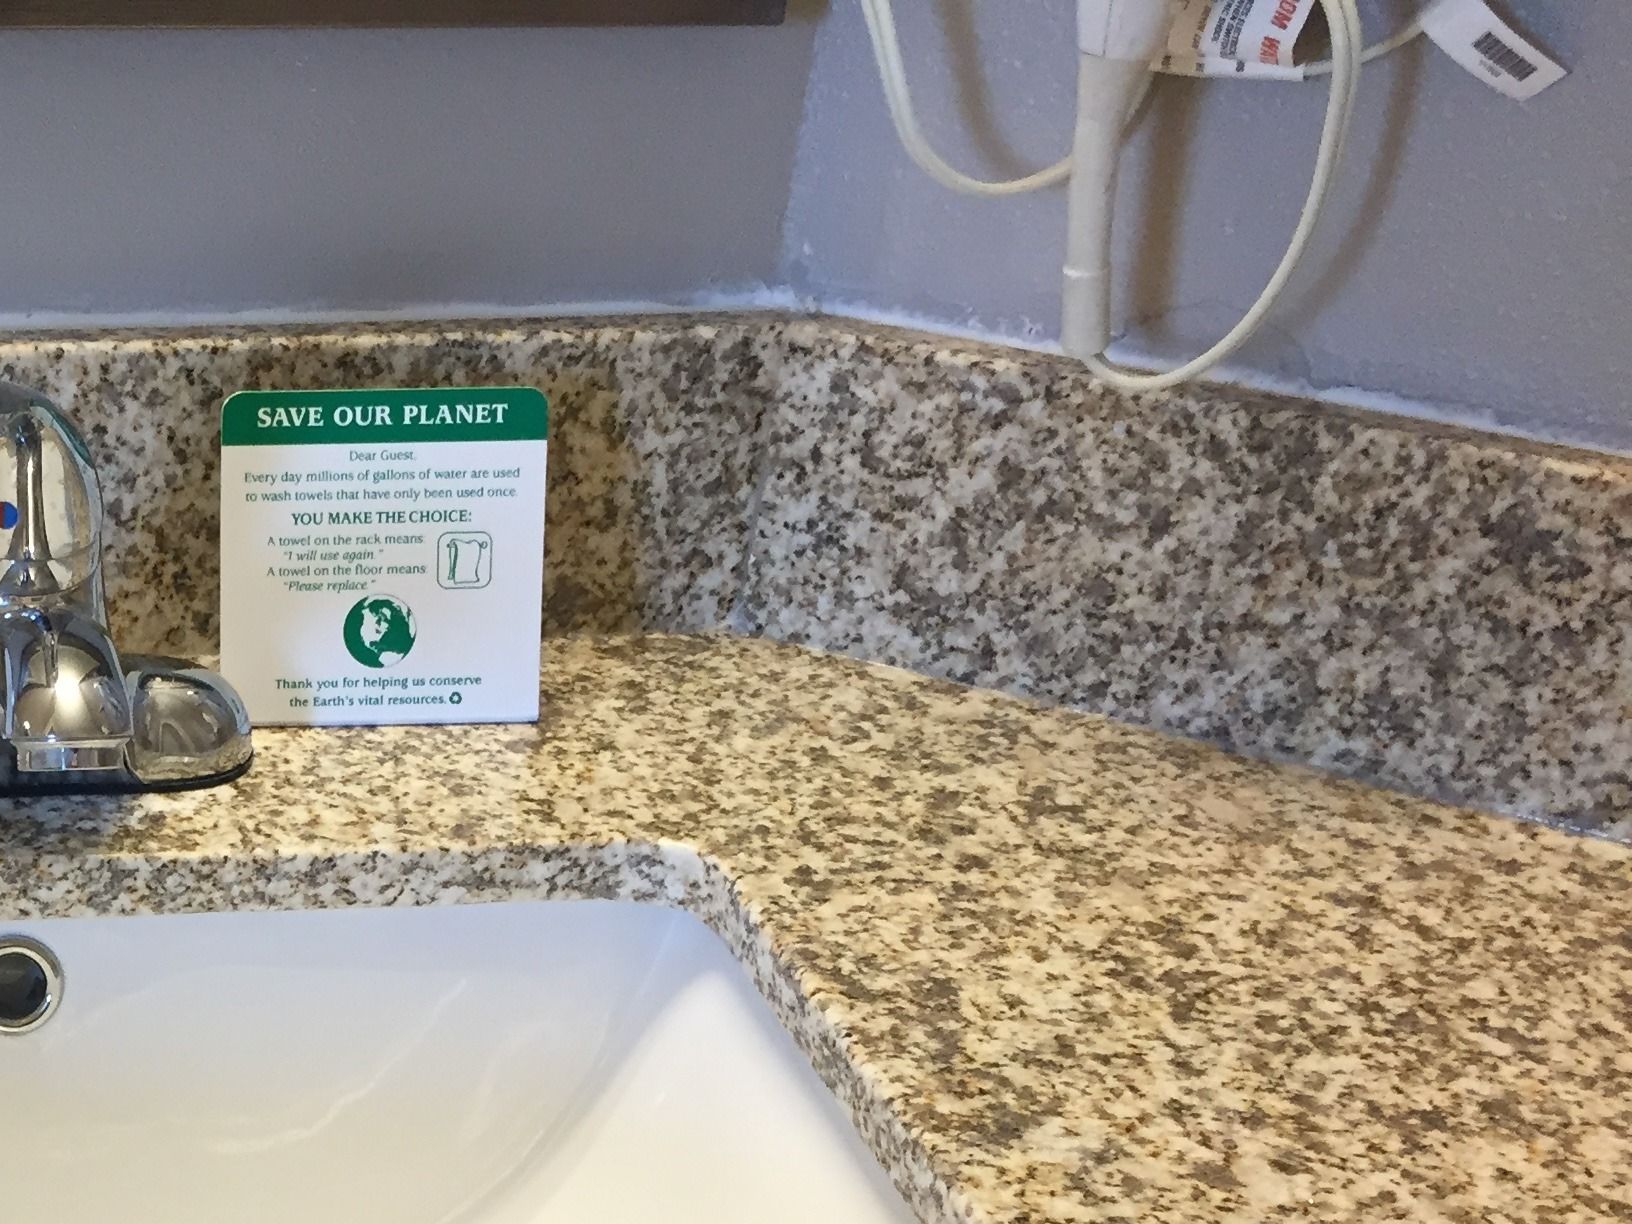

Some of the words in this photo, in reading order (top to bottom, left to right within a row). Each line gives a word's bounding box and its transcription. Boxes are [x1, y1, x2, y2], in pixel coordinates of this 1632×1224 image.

[257, 407, 323, 427] SAVE
[334, 406, 392, 426] OUR
[403, 404, 508, 424] PLANET
[350, 451, 376, 461] Dear
[245, 472, 277, 485] Every
[281, 471, 302, 483] day
[306, 470, 354, 482] millions
[357, 470, 370, 481] of
[373, 469, 415, 483] gallons
[419, 469, 431, 479] of
[434, 469, 467, 479] water
[471, 469, 489, 478] are
[492, 468, 520, 478] used
[245, 492, 258, 502] to
[261, 491, 291, 501] wash
[295, 490, 333, 501] towels
[336, 489, 359, 500] that
[363, 489, 391, 499] have
[395, 489, 420, 501] only
[424, 488, 452, 498] been
[456, 487, 483, 497] used
[291, 513, 323, 525] YOU
[328, 512, 373, 524] MAKE
[375, 511, 406, 524] THE
[409, 510, 472, 523] CHOICE:
[268, 537, 275, 546] A
[279, 535, 310, 546] towel
[314, 537, 329, 546] on
[333, 535, 351, 545] the
[356, 534, 381, 544] rack
[385, 534, 423, 544] means
[297, 551, 317, 561] will
[320, 552, 339, 560] use
[267, 567, 275, 576] A
[279, 566, 310, 576] towel
[314, 567, 329, 575] on
[333, 565, 351, 575] the
[355, 564, 383, 574] floor
[387, 565, 426, 574] means
[275, 678, 312, 689] Thank
[317, 679, 339, 691] you
[343, 677, 359, 687] for
[363, 677, 408, 689] helping
[412, 678, 426, 686] us
[429, 675, 482, 686] conserve
[290, 696, 308, 707] the
[313, 696, 354, 706] Earth's
[358, 694, 383, 705] vital
[387, 695, 446, 704] resources.
